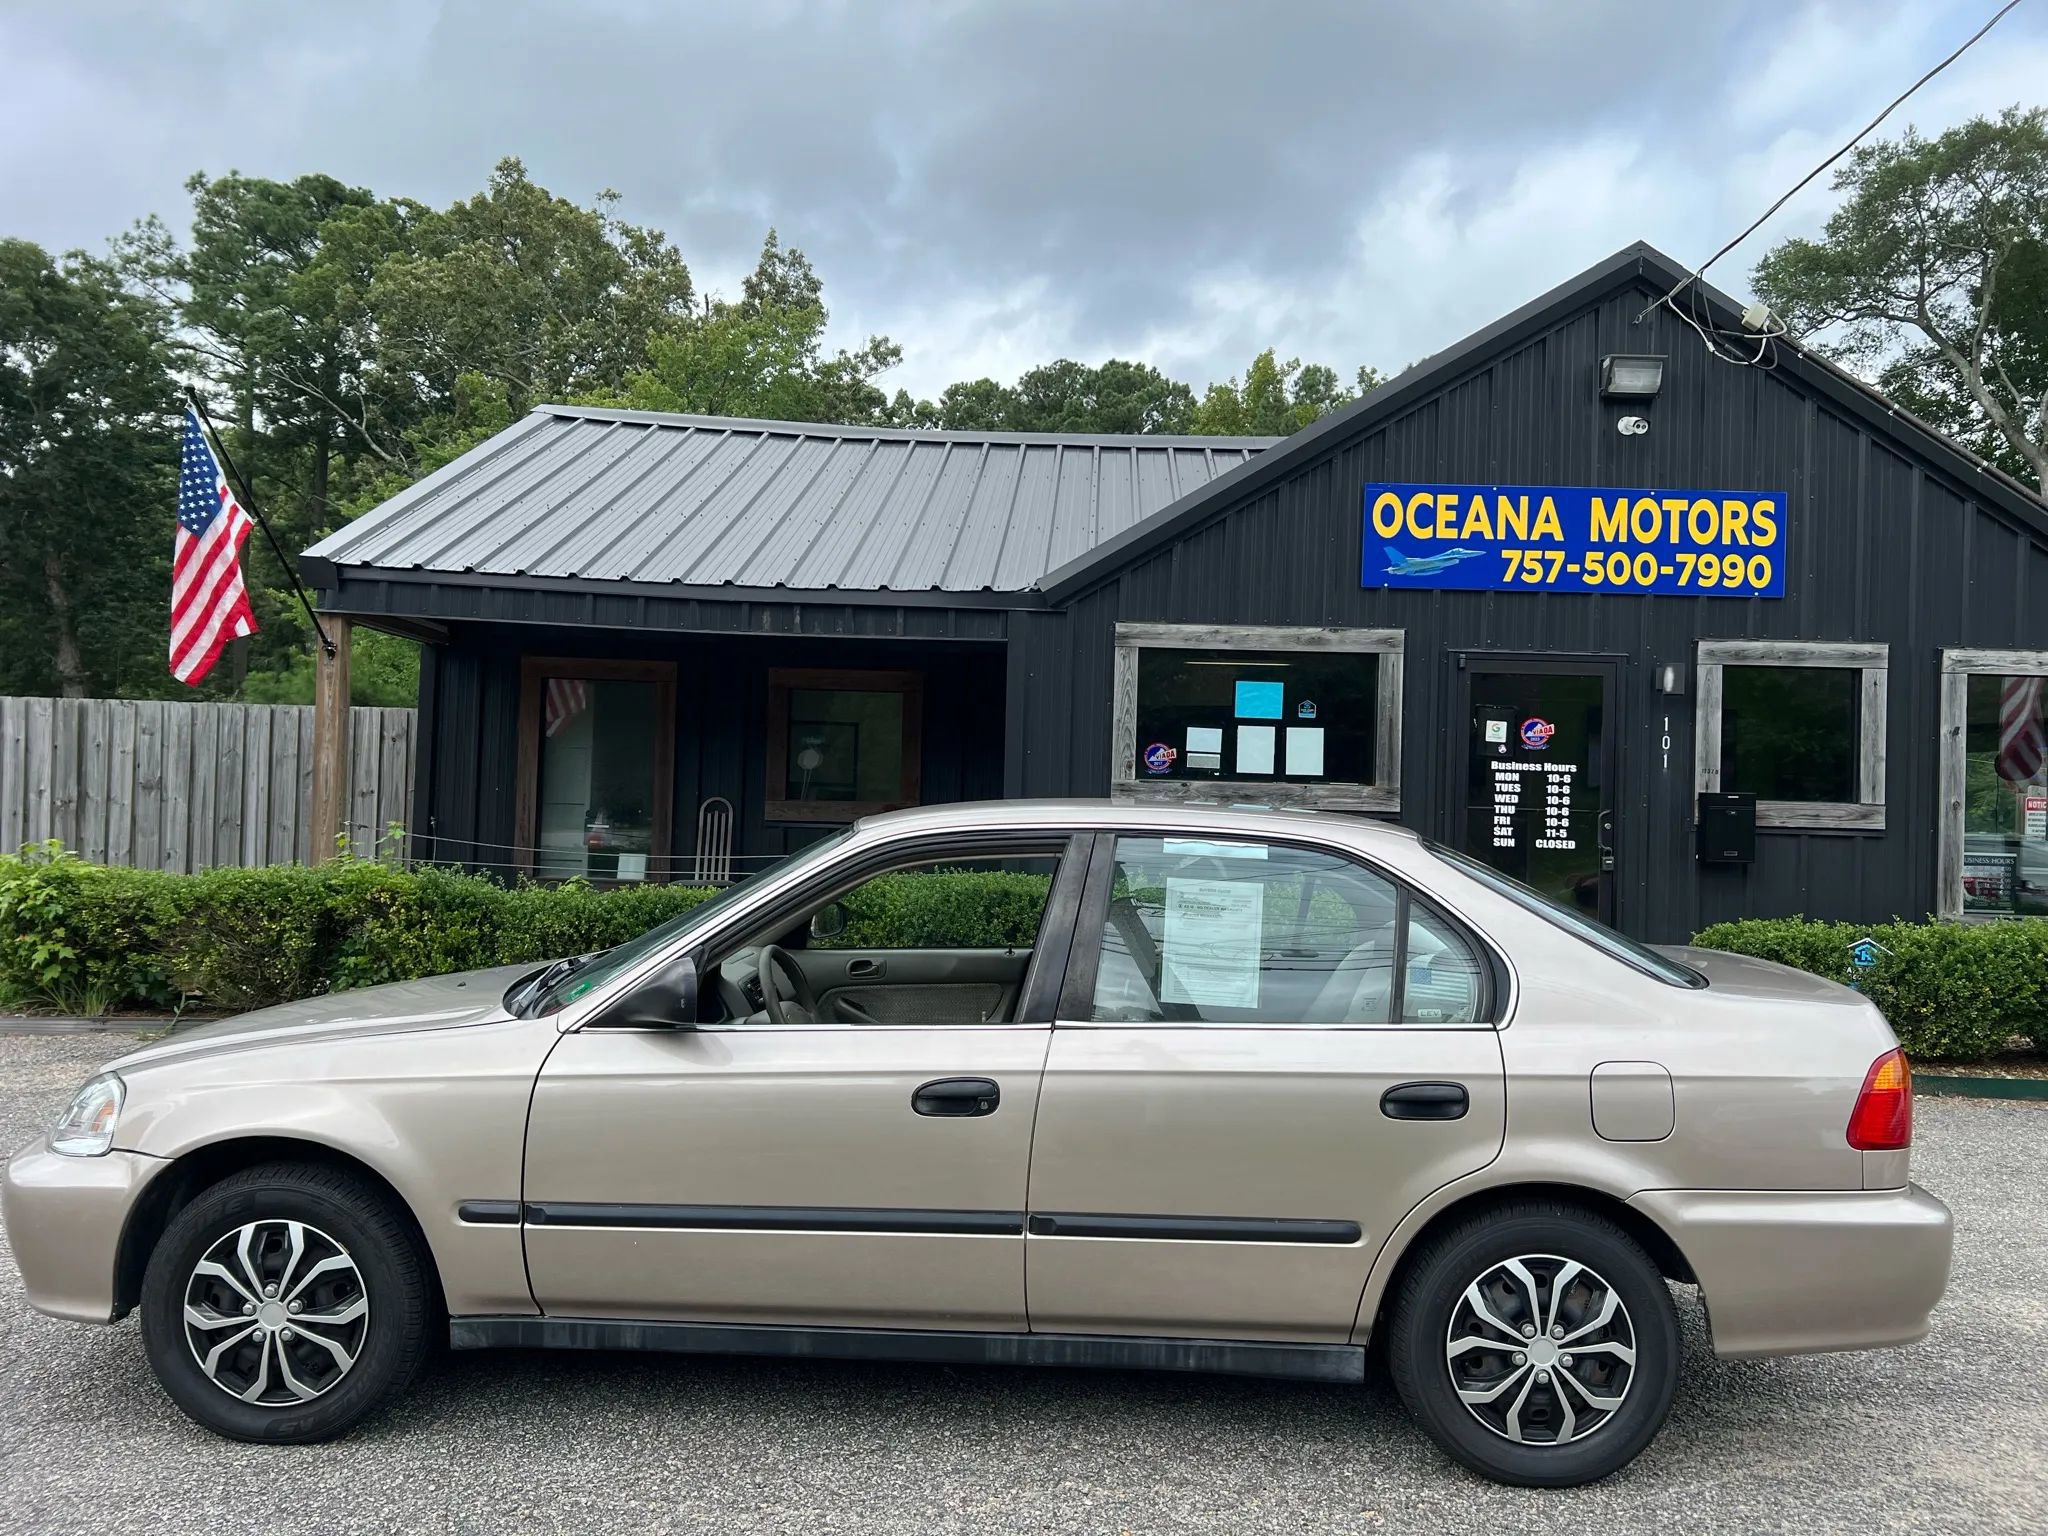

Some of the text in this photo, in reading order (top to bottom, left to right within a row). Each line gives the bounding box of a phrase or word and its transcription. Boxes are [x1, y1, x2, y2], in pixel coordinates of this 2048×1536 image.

[1372, 492, 1777, 547] OCEANA MOTORS
[1501, 549, 1772, 589] 757-500-7990
[1532, 725, 1553, 736] VIADA
[1662, 716, 1671, 769] 101
[1155, 750, 1176, 760] VIADA
[1491, 760, 1577, 773] Business Hours
[1495, 772, 1571, 783] MON 10-6
[1494, 783, 1570, 794] TUES 10-6
[1494, 794, 1570, 805] WED 10-6
[1493, 805, 1569, 816] THU 10-6
[1493, 816, 1569, 827] FRI 10-6
[1493, 826, 1567, 838] SAT 11-5
[1493, 837, 1576, 849] SUN CLOSED
